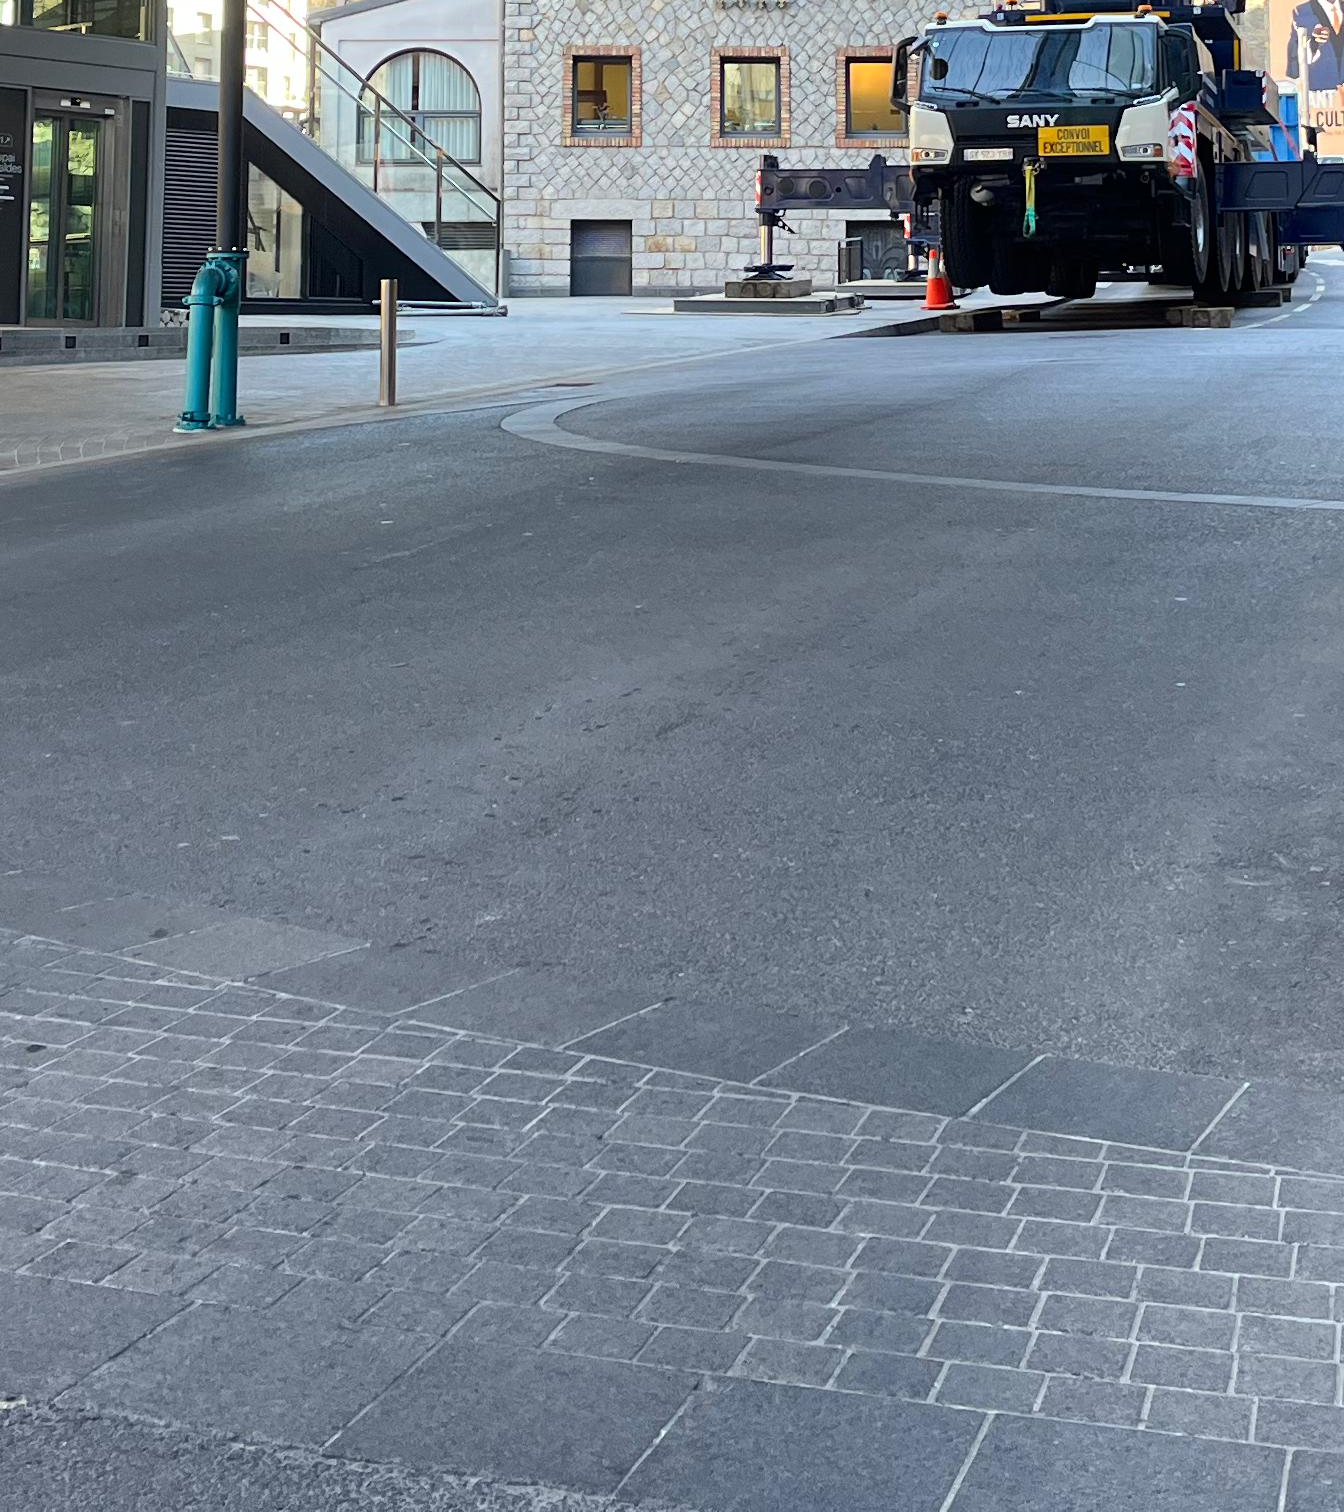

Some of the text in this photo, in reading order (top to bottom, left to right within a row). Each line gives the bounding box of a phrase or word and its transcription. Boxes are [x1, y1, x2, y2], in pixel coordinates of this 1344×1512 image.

[1007, 114, 1059, 128] SANY
[1057, 128, 1090, 140] CONVOI
[1043, 141, 1104, 154] EXCEPTIONNEL
